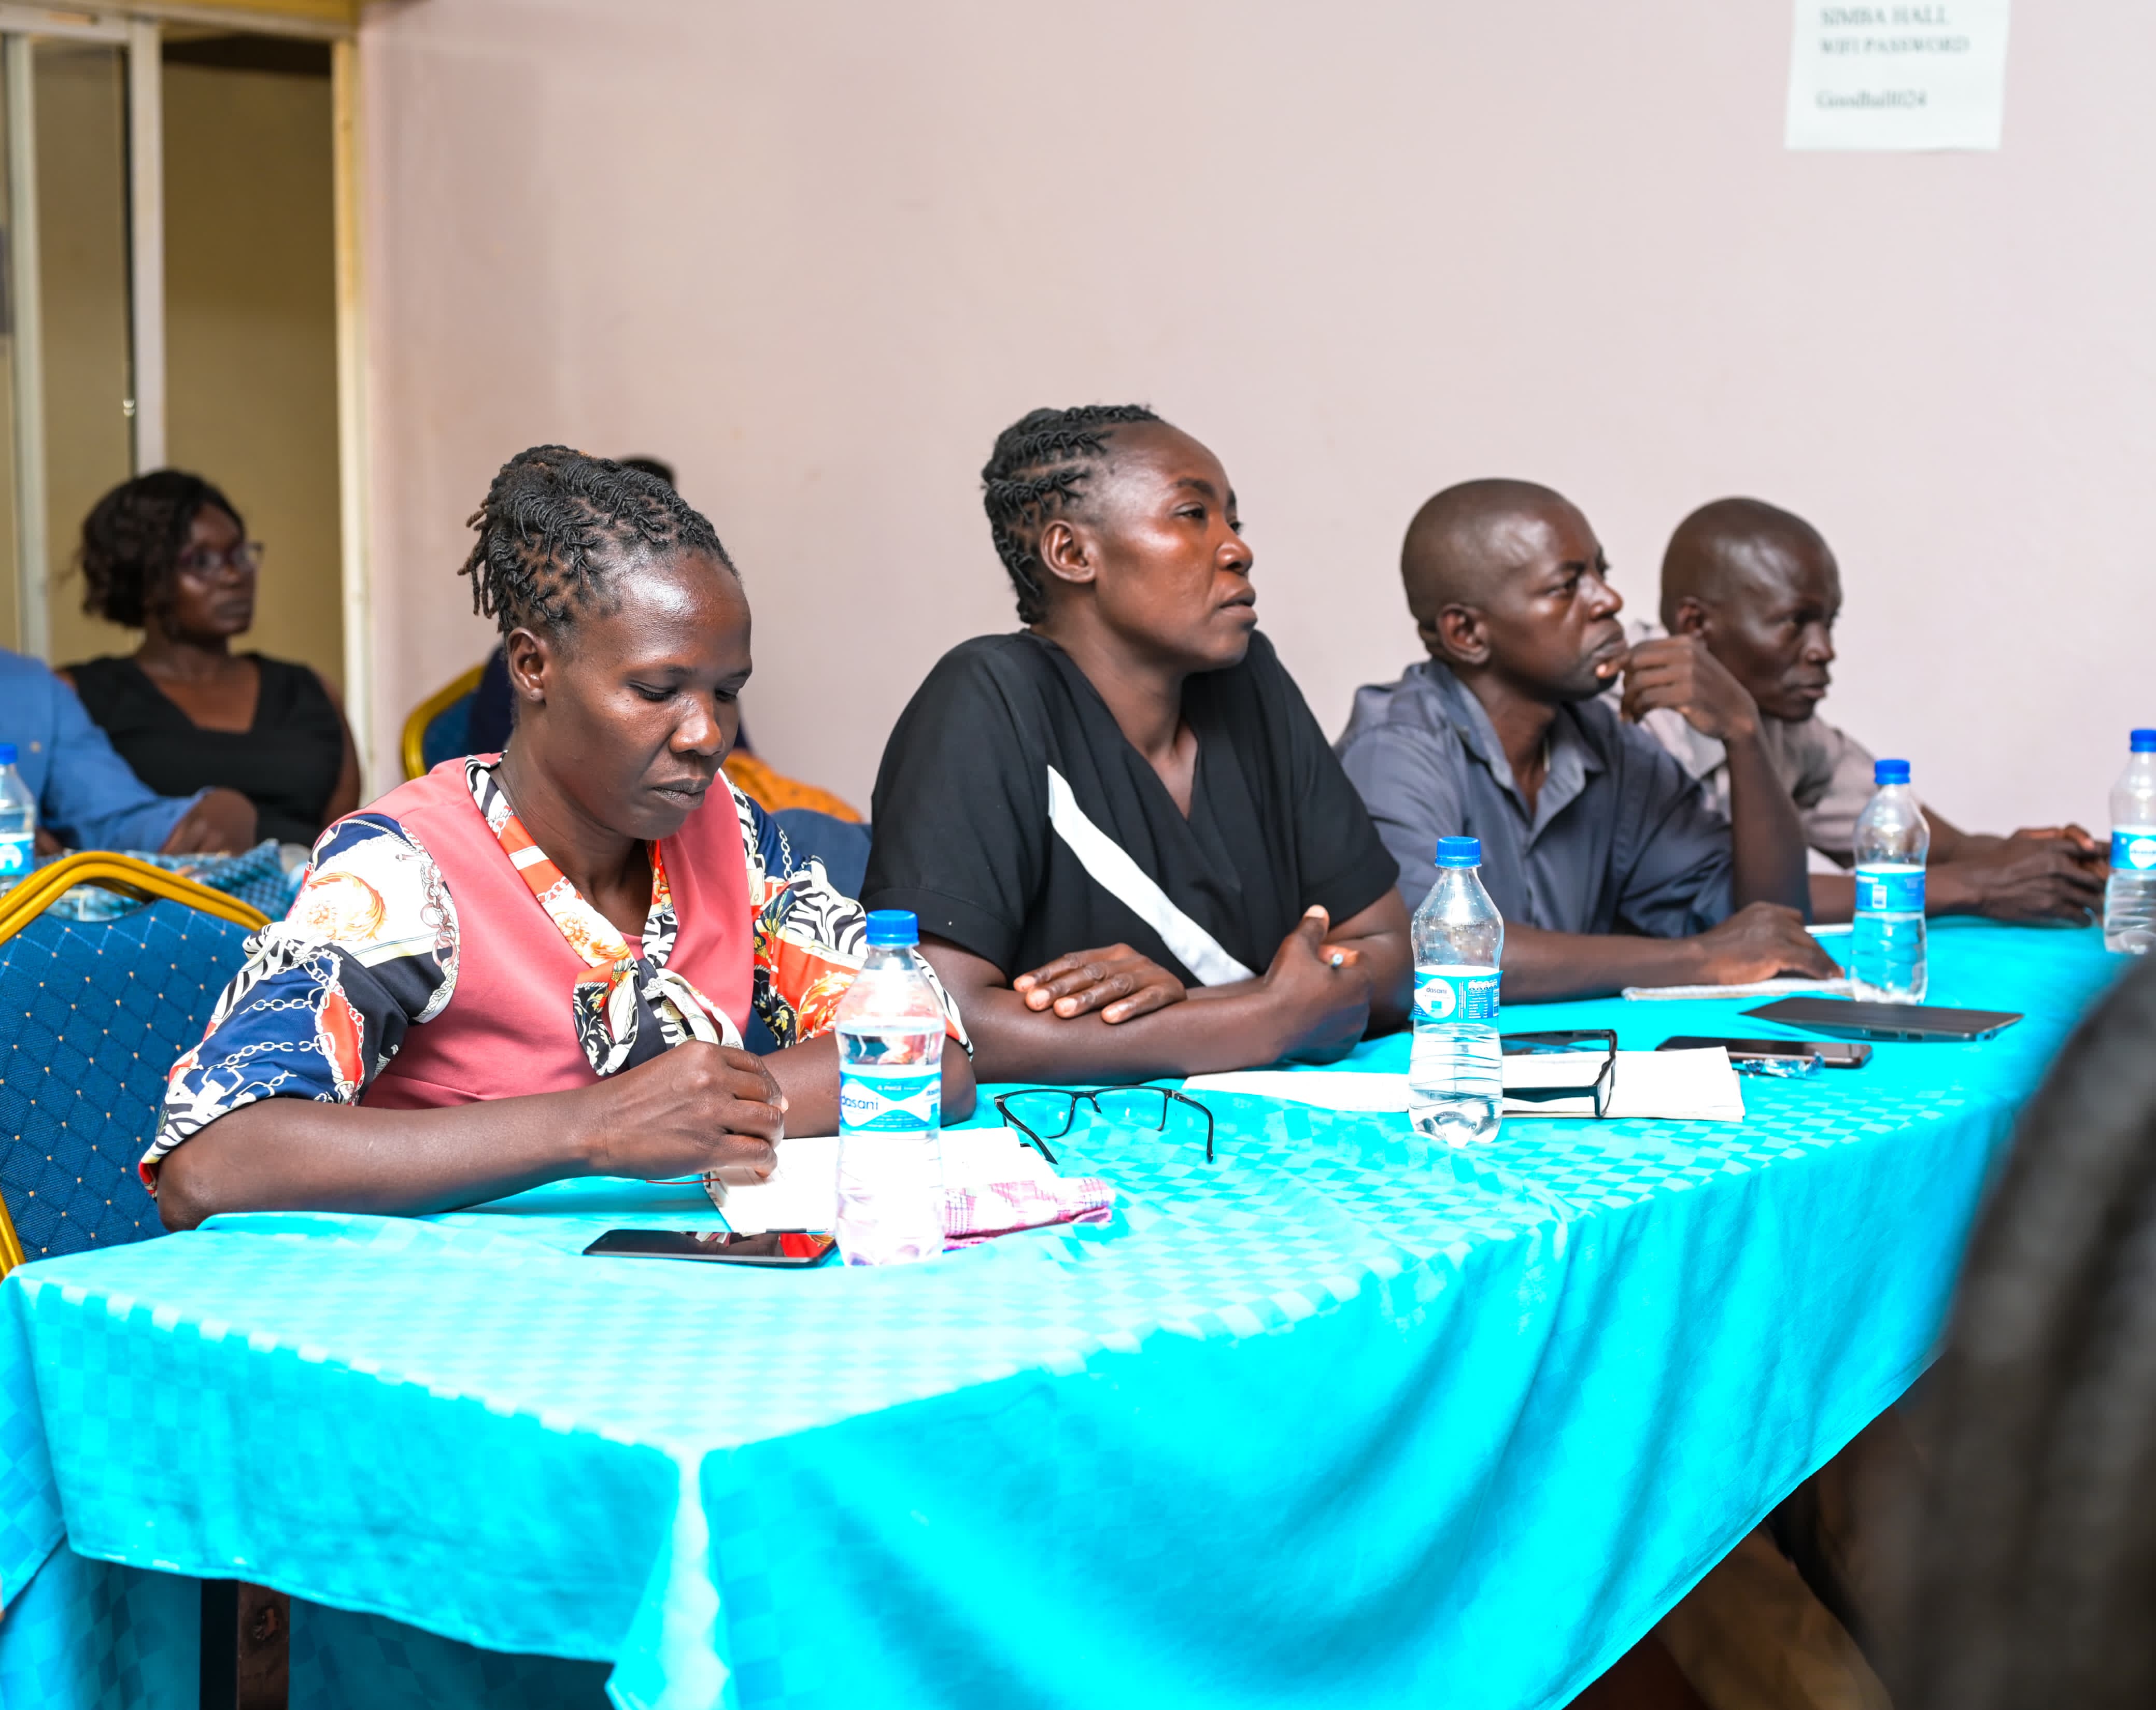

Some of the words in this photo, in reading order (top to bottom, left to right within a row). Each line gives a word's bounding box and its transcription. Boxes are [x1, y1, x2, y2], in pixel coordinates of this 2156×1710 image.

[1820, 6, 1887, 26] SIMBA
[1891, 5, 1951, 25] HALL
[1863, 35, 1971, 54] PASSWORD
[1426, 986, 1447, 995] dasani
[841, 1095, 878, 1111] dasani
